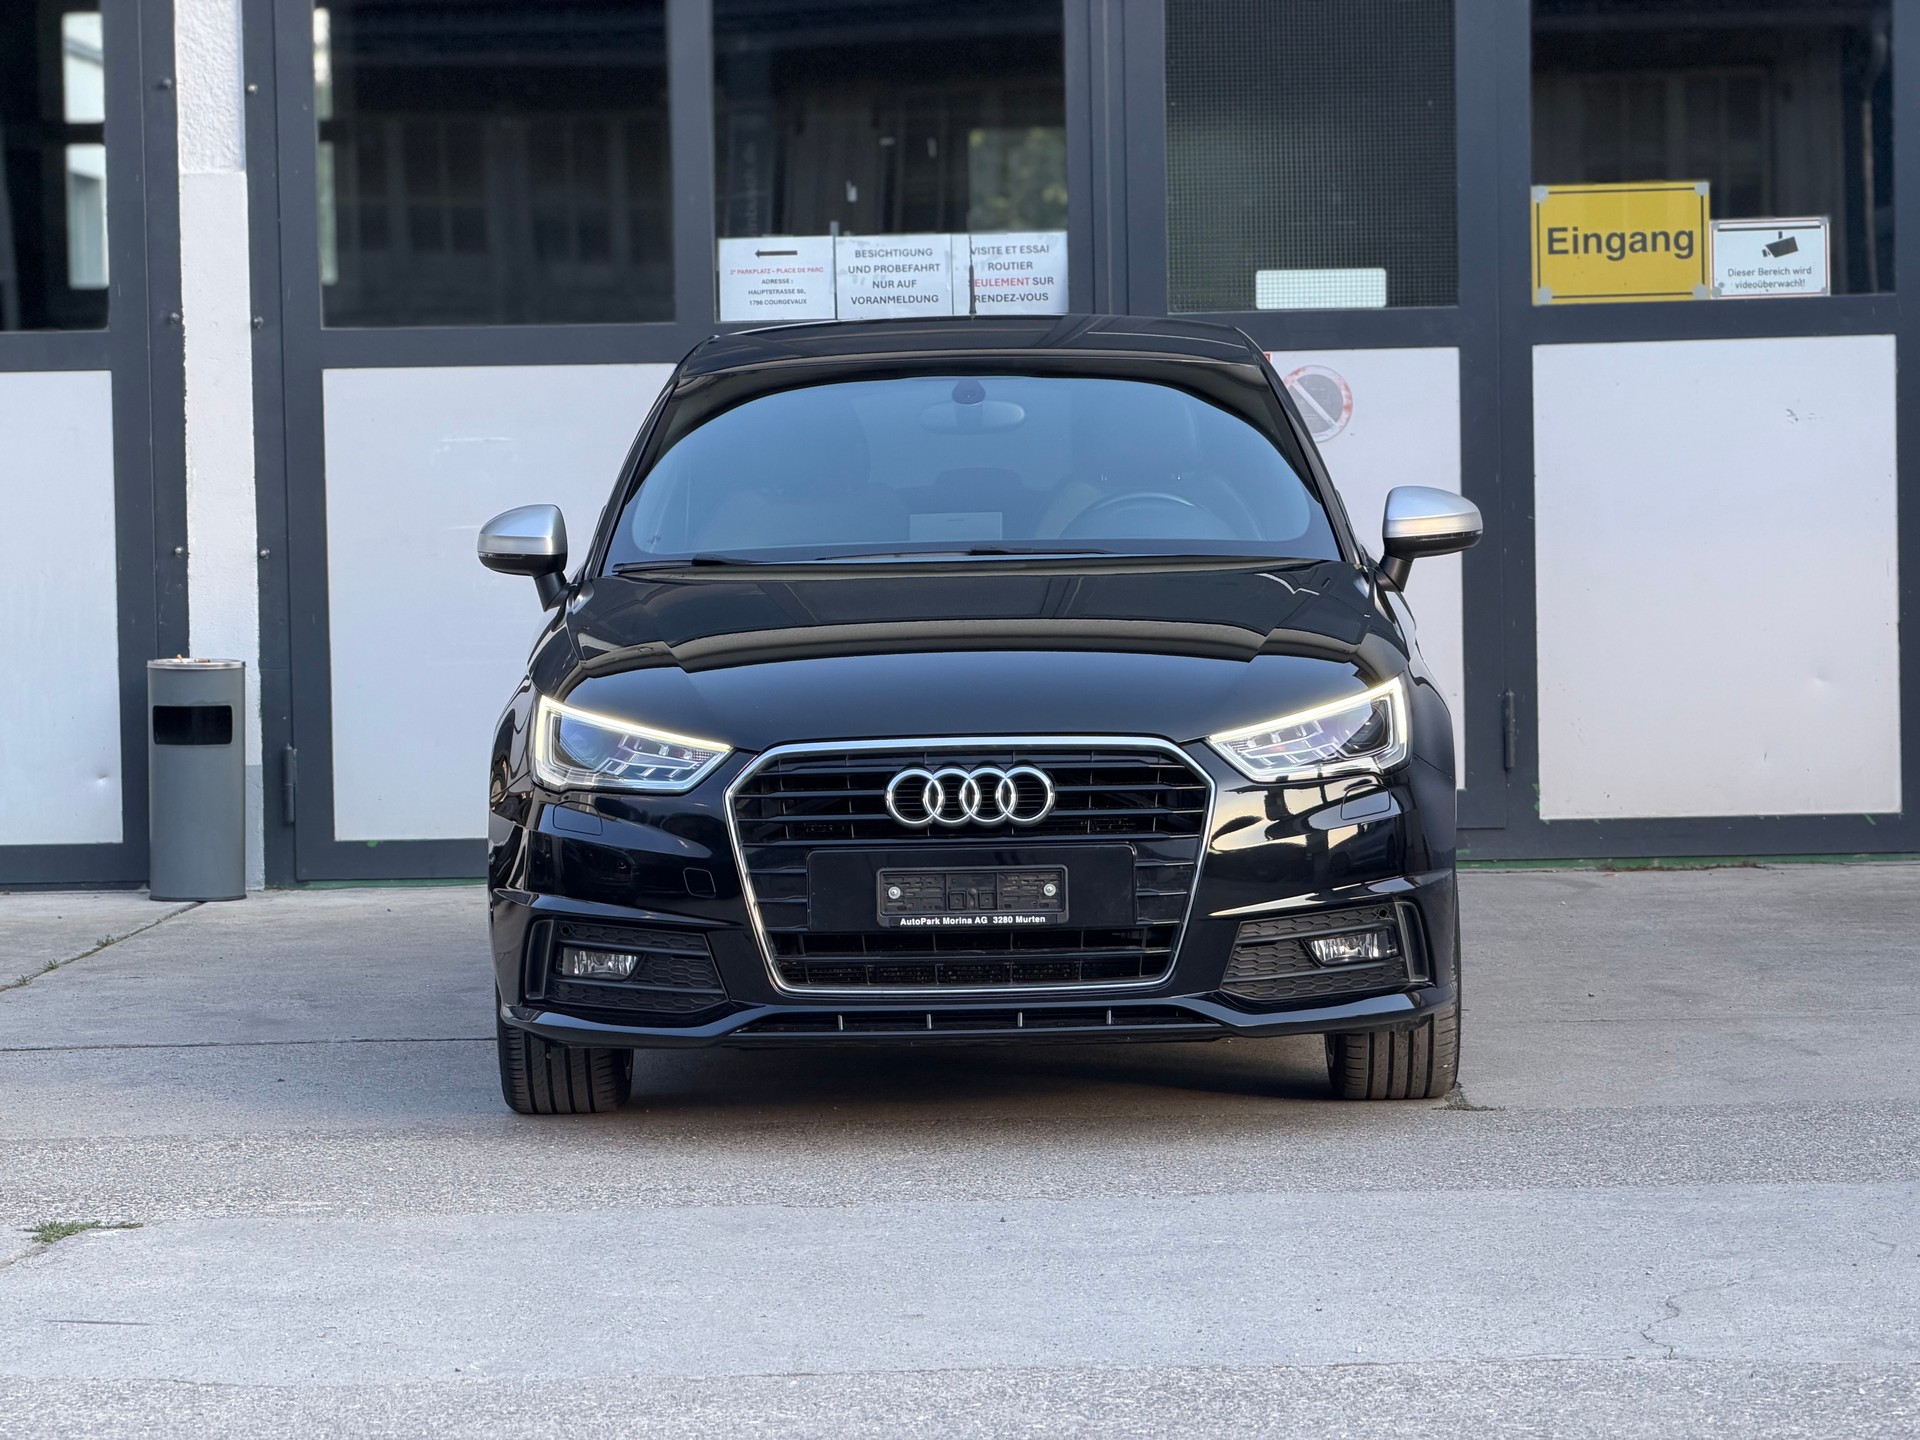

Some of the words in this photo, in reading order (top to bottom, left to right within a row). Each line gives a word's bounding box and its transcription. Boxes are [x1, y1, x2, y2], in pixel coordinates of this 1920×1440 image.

[1547, 226, 1694, 261] Eingang
[855, 248, 933, 258] BESICHTIGUNG
[971, 246, 1002, 255] VISITE
[1005, 246, 1018, 254] ET
[1020, 245, 1049, 254] ESSAI
[848, 265, 871, 274] UND
[873, 263, 941, 273] PROBEFAHRT
[988, 261, 1033, 271] ROUTIER
[1727, 268, 1755, 277] Dieser
[1758, 267, 1790, 276] Bereich
[1792, 266, 1812, 275] wird
[872, 280, 895, 289] NUR
[897, 280, 917, 288] AUF
[969, 277, 1030, 287] EULEMENT
[1032, 276, 1054, 286] SUR
[1735, 278, 1806, 289] videoüberwacht!
[851, 295, 939, 304] VORANMELDUNG
[975, 293, 1049, 303] RENDEZ-VOUS
[900, 917, 940, 926] AutoPark
[943, 916, 972, 925] Morina
[974, 916, 988, 924] AG
[1015, 915, 1045, 923] Murten
